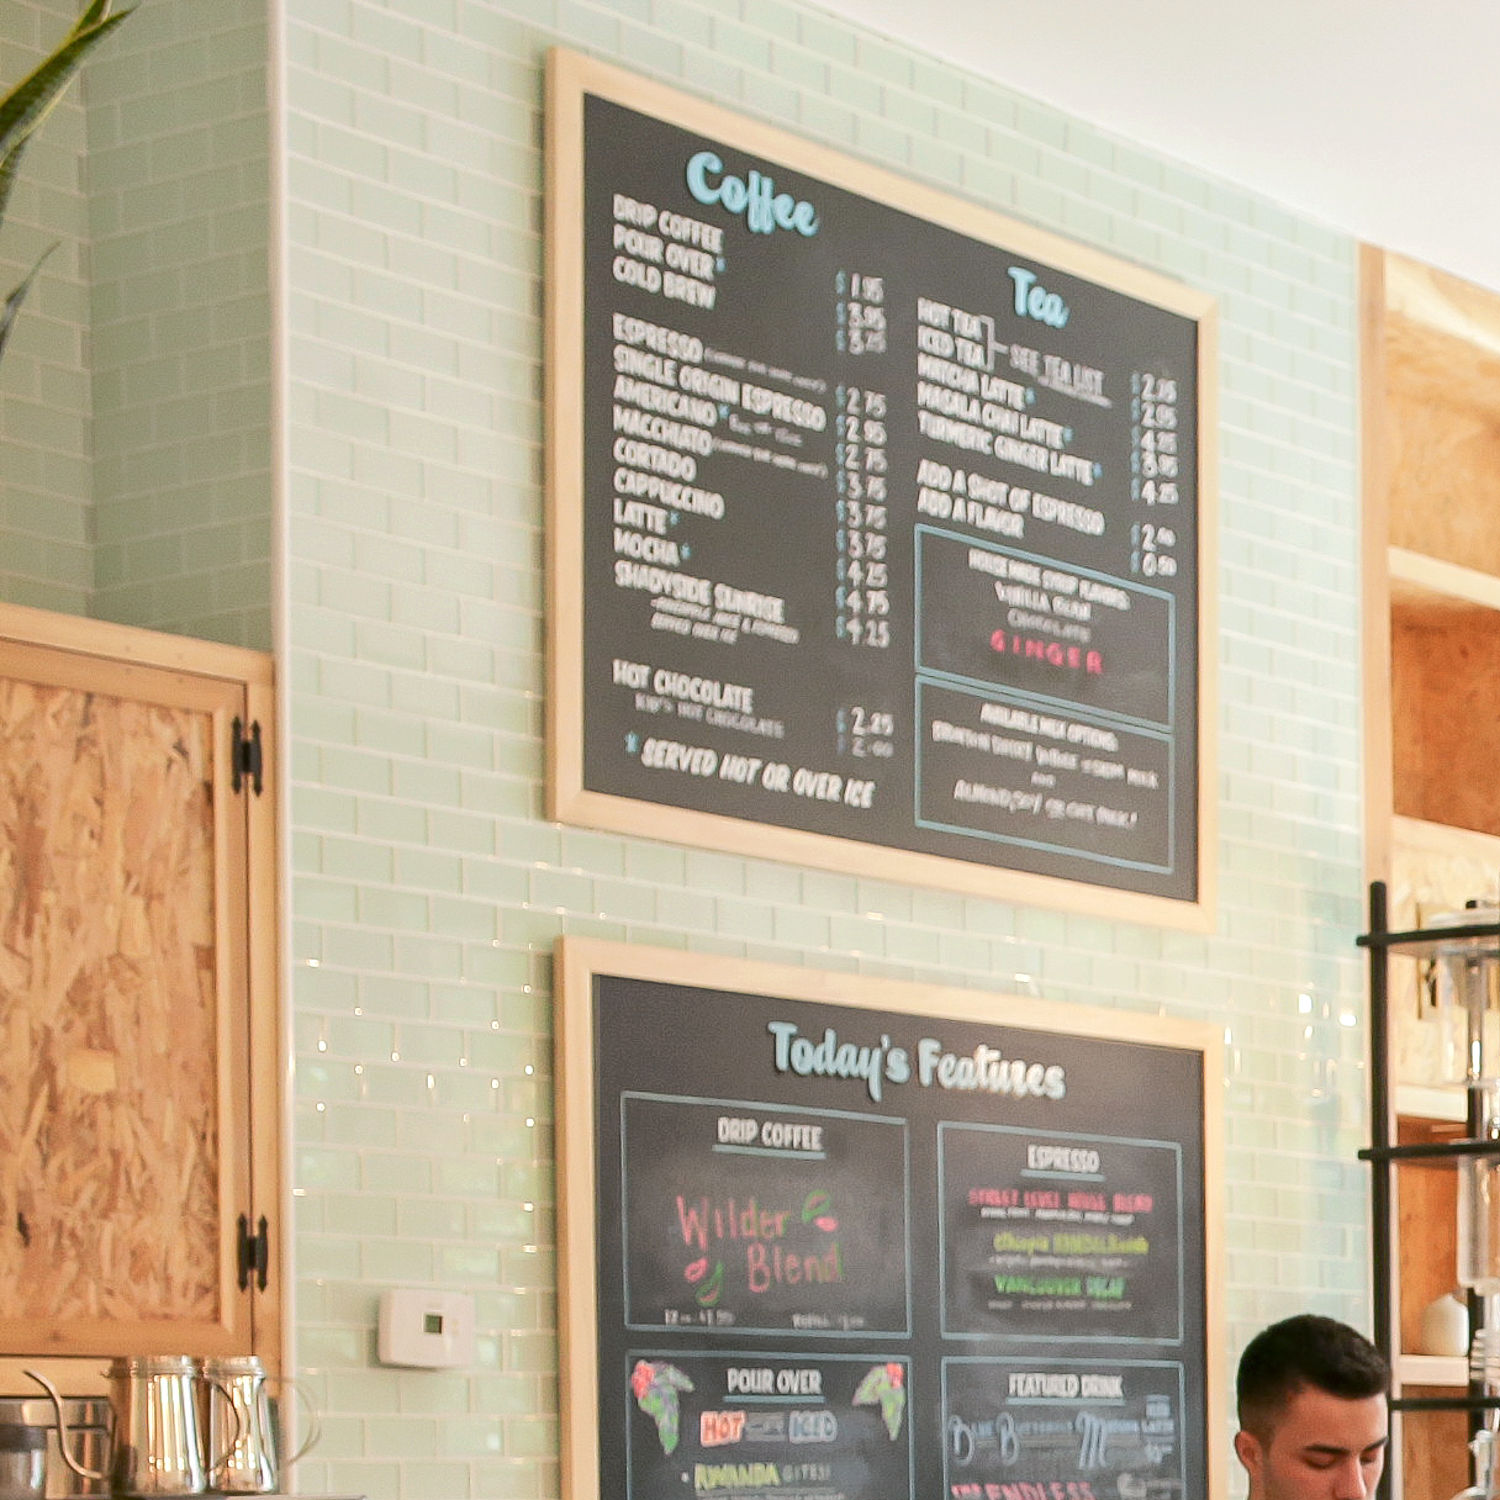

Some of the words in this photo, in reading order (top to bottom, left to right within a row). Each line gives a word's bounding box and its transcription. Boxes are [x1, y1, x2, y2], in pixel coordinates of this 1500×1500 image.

[686, 151, 820, 237] Coffee
[613, 193, 658, 228] DRIP
[658, 210, 724, 254] COFFEE
[613, 223, 664, 264] POUR
[665, 242, 715, 281] OVER
[613, 255, 662, 294] COLD
[1007, 266, 1070, 329] Tea
[612, 312, 703, 363] ESPRESSO
[954, 337, 985, 370] TEA
[613, 344, 678, 386] SINGLE
[679, 365, 741, 405] ORIGIN
[741, 383, 827, 432] ESPRESSO
[613, 374, 718, 427] AMERICANO
[613, 404, 713, 456] MACCHIATO
[613, 437, 697, 482] CORTADO
[613, 466, 725, 520] CAPPUCCINO
[613, 498, 669, 535] LATTE
[952, 469, 967, 495] A
[1032, 492, 1105, 536] ESPRESSO
[952, 496, 967, 523] A
[613, 527, 680, 567] MOCHA
[614, 559, 712, 606] SHADYSIDE
[991, 629, 1102, 674] GINGER
[612, 658, 650, 689] HOT
[653, 668, 754, 715] CHOCOLATE
[641, 737, 718, 777] SERVED
[719, 753, 763, 784] HOT
[763, 761, 791, 792] OR
[793, 768, 842, 802] OVER
[844, 778, 876, 809] ICE
[768, 1021, 912, 1102] Today's
[917, 1038, 1066, 1100] Features
[717, 1117, 758, 1145] DRIP
[761, 1121, 824, 1151] COFFEE
[1028, 1144, 1100, 1173] ESPRESSO
[677, 1195, 791, 1250] Wilder
[747, 1241, 845, 1292] Blend
[727, 1368, 774, 1393] POUR
[777, 1369, 822, 1394] OVER
[1008, 1372, 1079, 1398] FEATURED
[1081, 1373, 1123, 1397] DRINK
[700, 1410, 746, 1447] HOT
[789, 1410, 838, 1444] ICED
[695, 1462, 781, 1490] RWANDA
